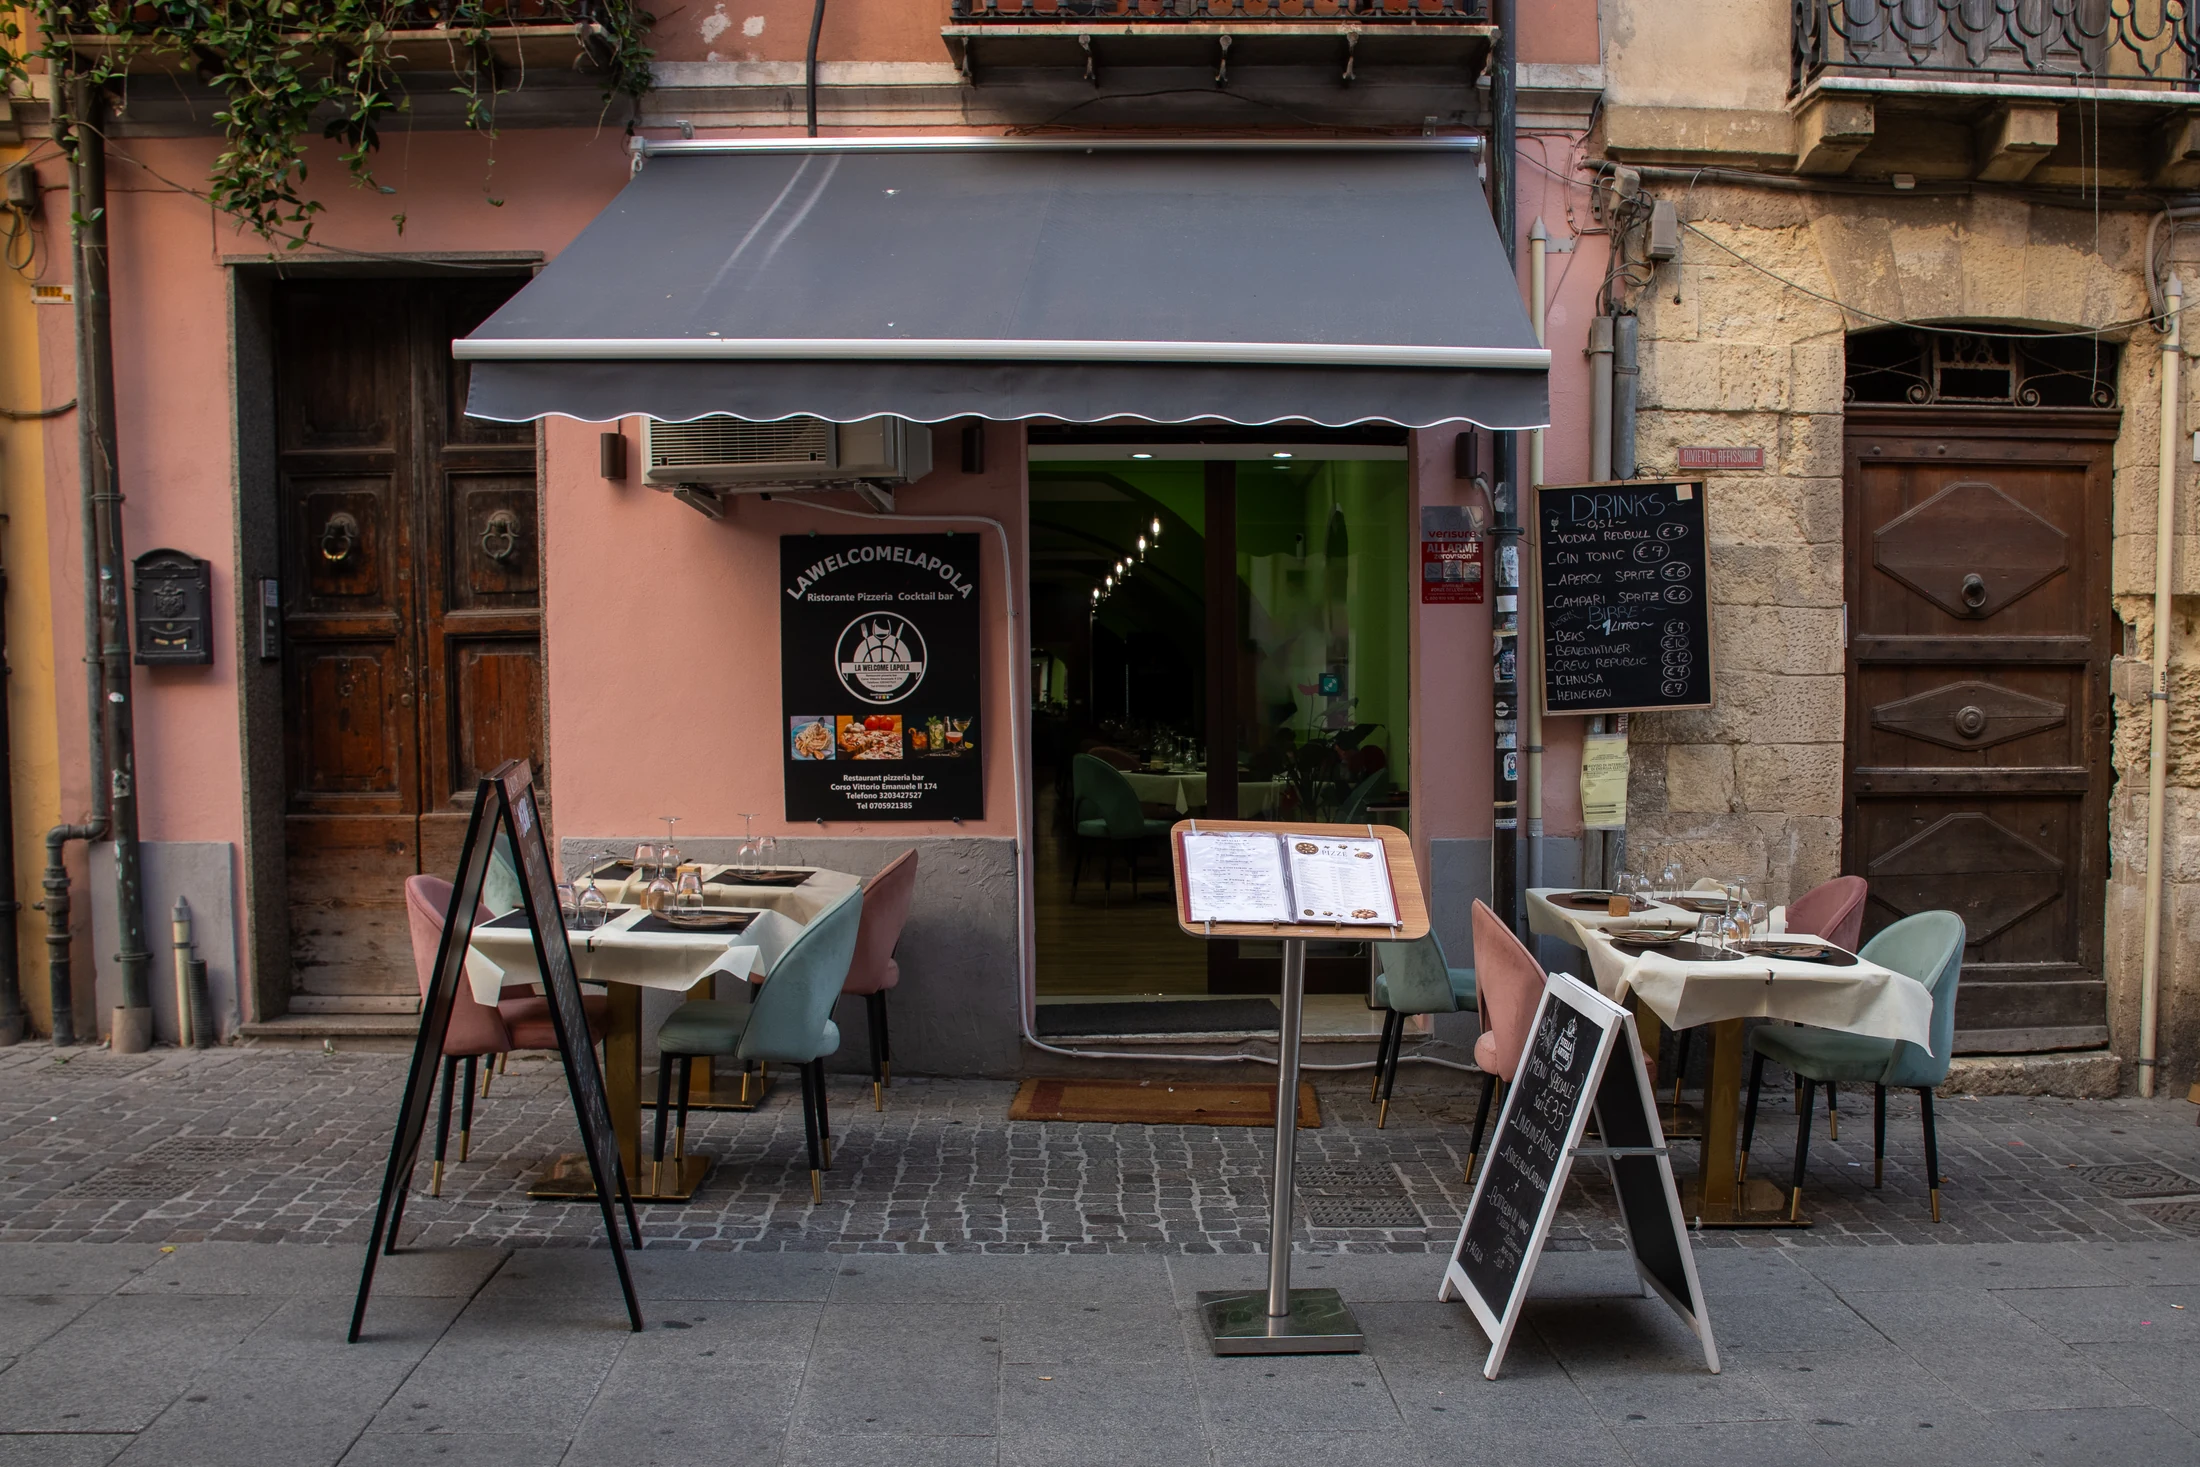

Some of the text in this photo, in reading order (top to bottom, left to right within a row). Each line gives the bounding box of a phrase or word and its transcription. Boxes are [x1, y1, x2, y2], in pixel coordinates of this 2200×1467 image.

[1684, 450, 1710, 463] DIVIETO
[1718, 450, 1758, 463] AFFISSIONE
[1572, 493, 1665, 521] DRINKS
[1428, 530, 1477, 539] verisure
[1558, 534, 1596, 544] VODKA
[1604, 530, 1651, 540] REDBULL
[1427, 543, 1479, 553] ALLARME
[1557, 552, 1579, 564] GIN
[1585, 550, 1625, 562] TONIC
[787, 546, 973, 600] LAWELCOMELAPOLA
[1559, 574, 1602, 586] APEROL
[1615, 570, 1655, 582] SPRITZ
[807, 592, 954, 602] Ristorante Pizzeria Cocktail bar
[1554, 594, 1605, 608] CAMPARI
[1619, 592, 1659, 604] SPRITZ
[1588, 605, 1638, 622] BIRRE
[1555, 643, 1631, 656] BENEDIKTINER
[1554, 660, 1590, 671] CREW
[1596, 657, 1648, 668] REPUBLIC
[1556, 674, 1604, 686] ICHNUSA
[1556, 688, 1612, 700] HEINEKEN
[883, 774, 910, 782] pizzeria
[1321, 849, 1348, 857] PIZZE
[1536, 1128, 1558, 1161] ASTICE
